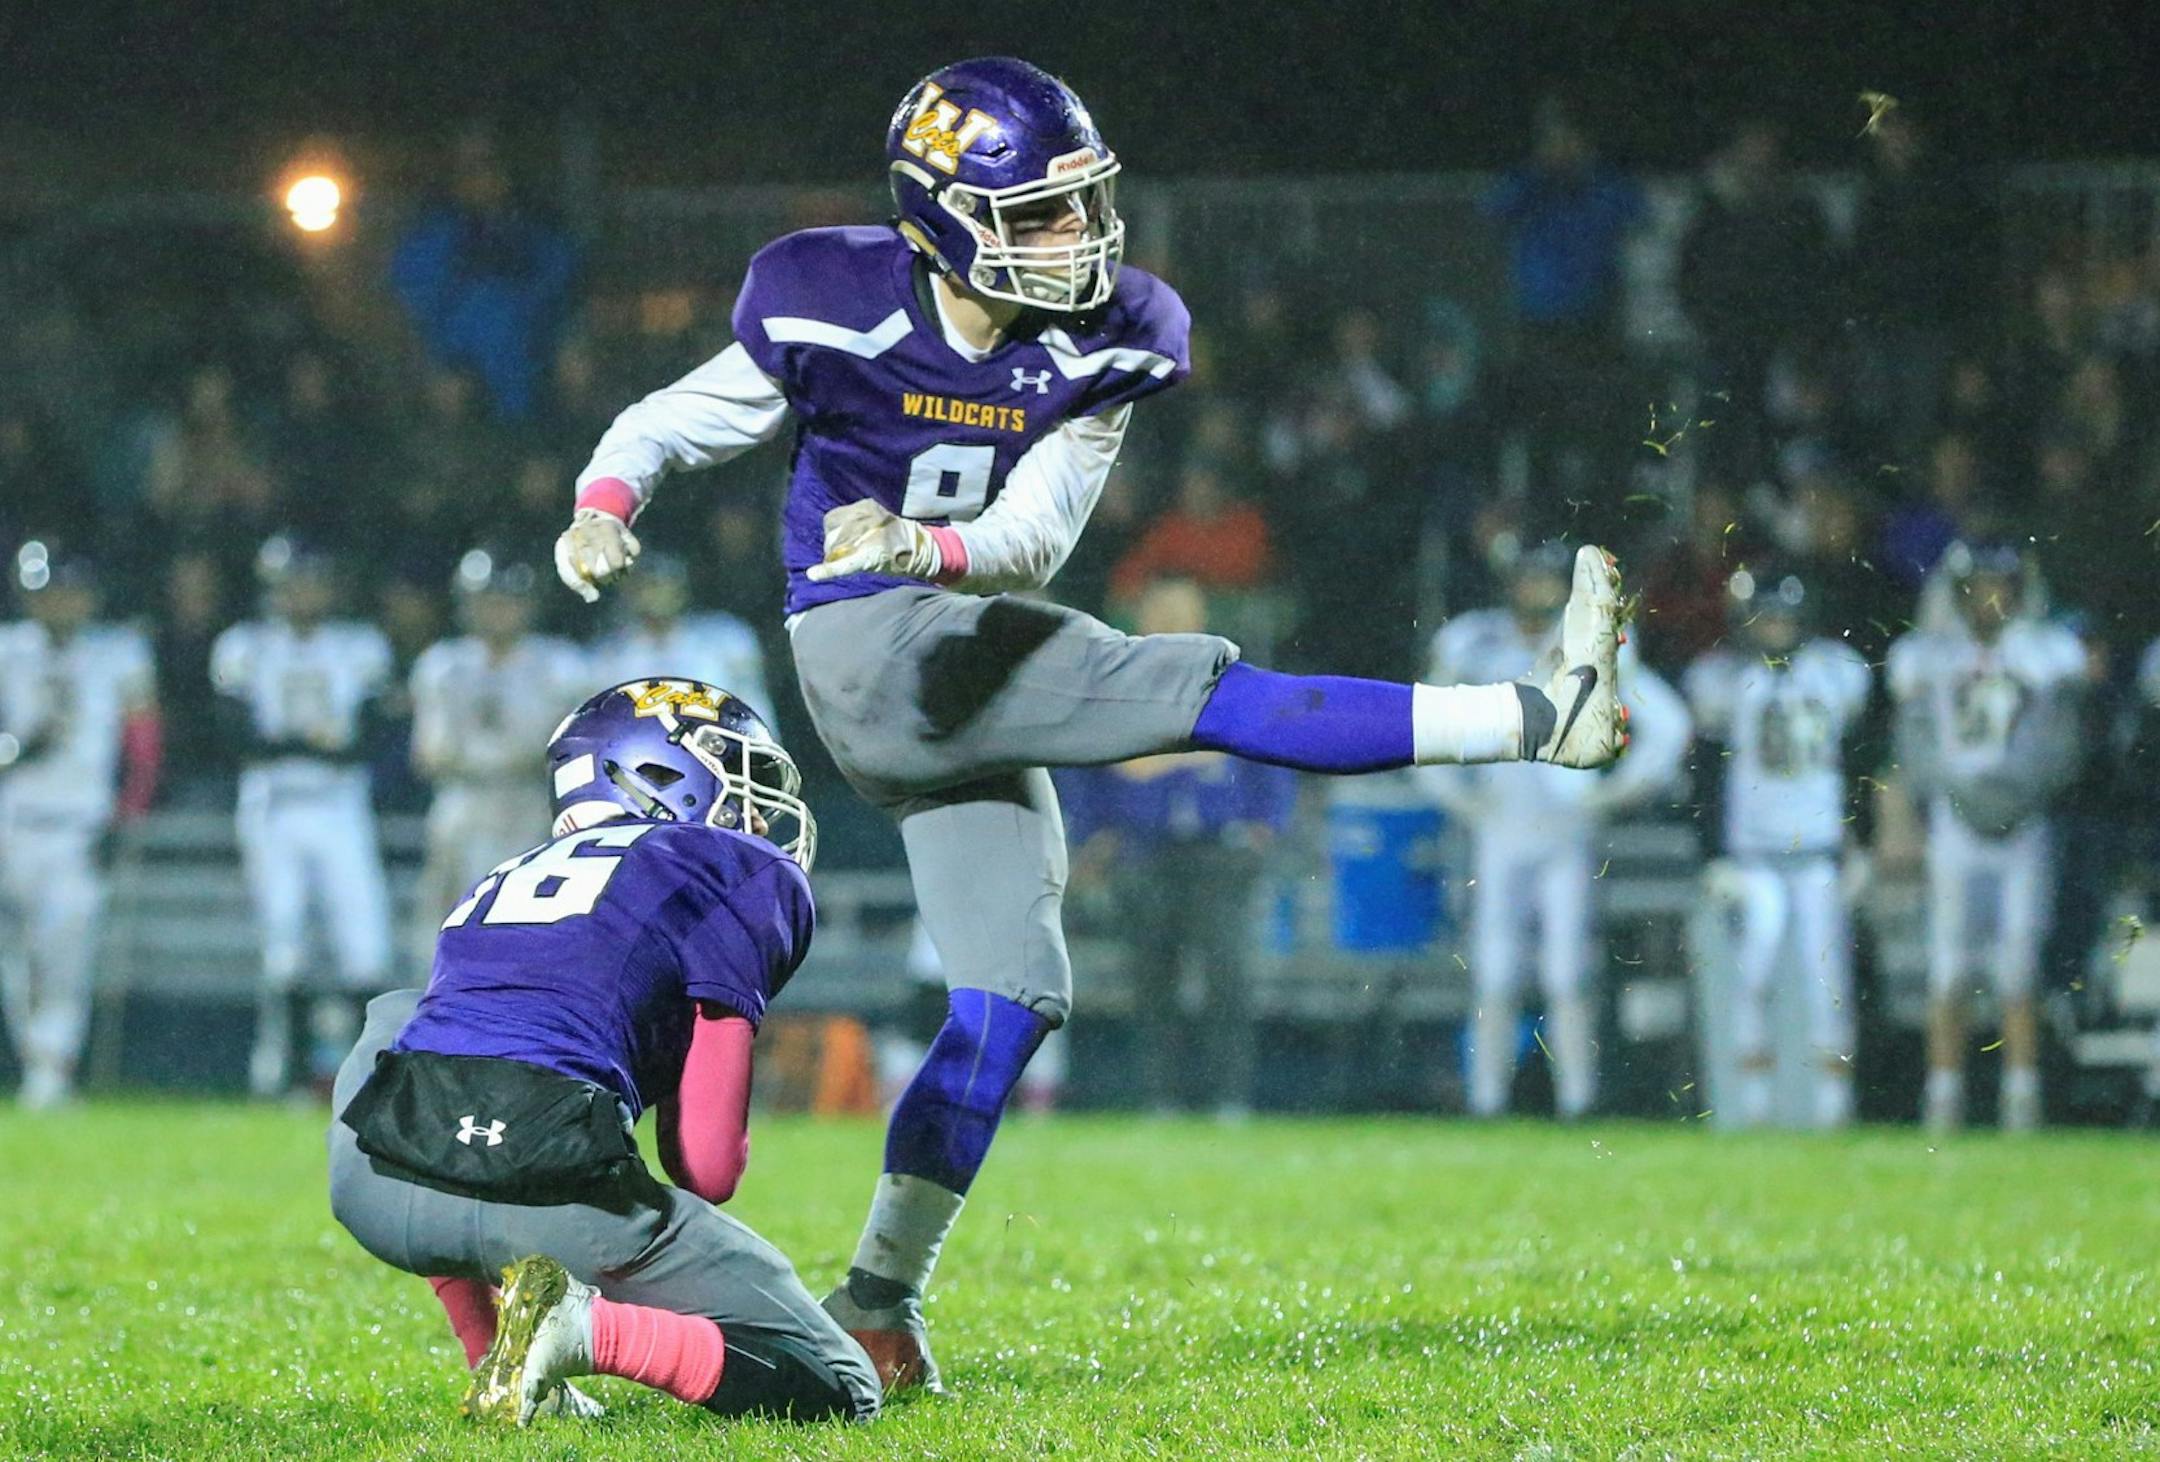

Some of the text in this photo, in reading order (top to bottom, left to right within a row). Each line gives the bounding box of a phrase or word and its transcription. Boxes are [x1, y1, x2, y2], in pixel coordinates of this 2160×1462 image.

[902, 81, 998, 176] W
[1056, 151, 1095, 173] Ridde
[903, 392, 1026, 432] WILDCATS
